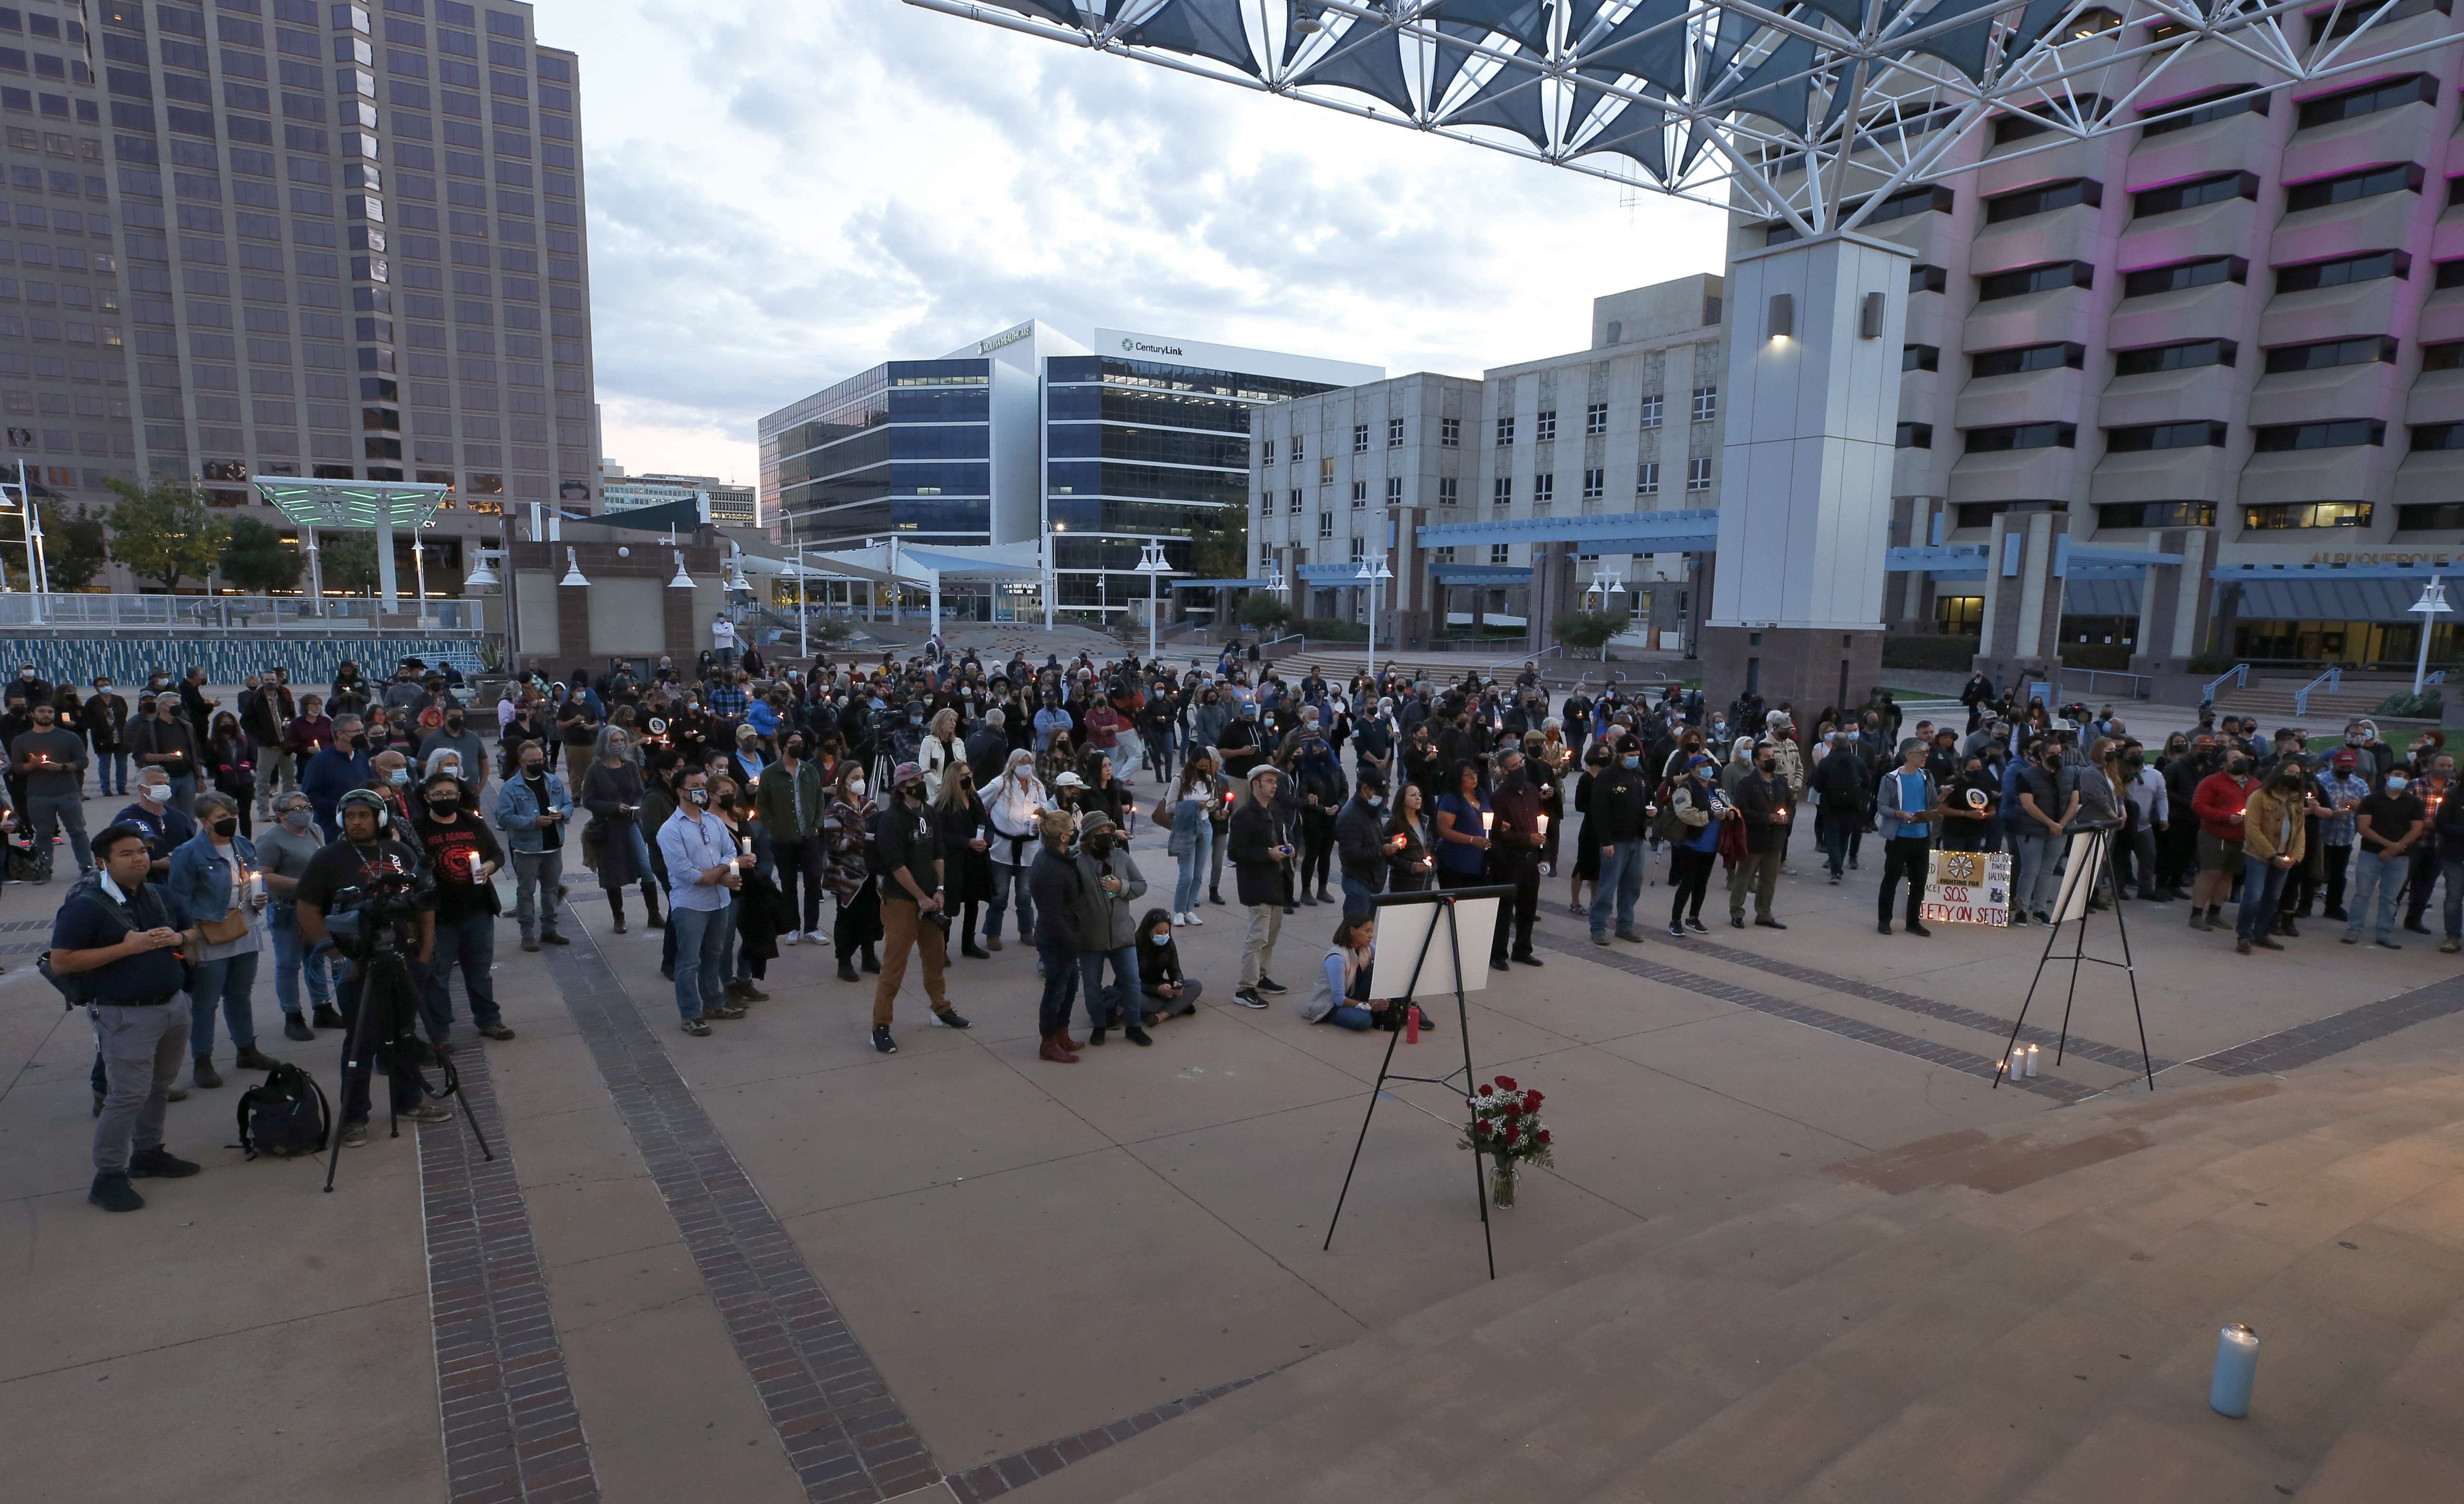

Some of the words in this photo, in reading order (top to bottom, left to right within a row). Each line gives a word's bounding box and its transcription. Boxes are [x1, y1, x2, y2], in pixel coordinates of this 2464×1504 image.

[983, 338, 1000, 352] MOLINA
[1001, 326, 1030, 346] HEALTHCARE
[1136, 342, 1183, 356] CenturyLink
[2309, 552, 2448, 564] ALBUQUERQUE
[136, 821, 149, 831] LA
[445, 831, 476, 842] AGAINST
[389, 853, 409, 893] ATLAA
[1992, 862, 2006, 871] POWER
[1989, 872, 2010, 881] HALYNA!
[1944, 886, 1970, 903] S.O.S.
[1956, 906, 1972, 921] ON
[1976, 907, 2007, 924] SETS!
